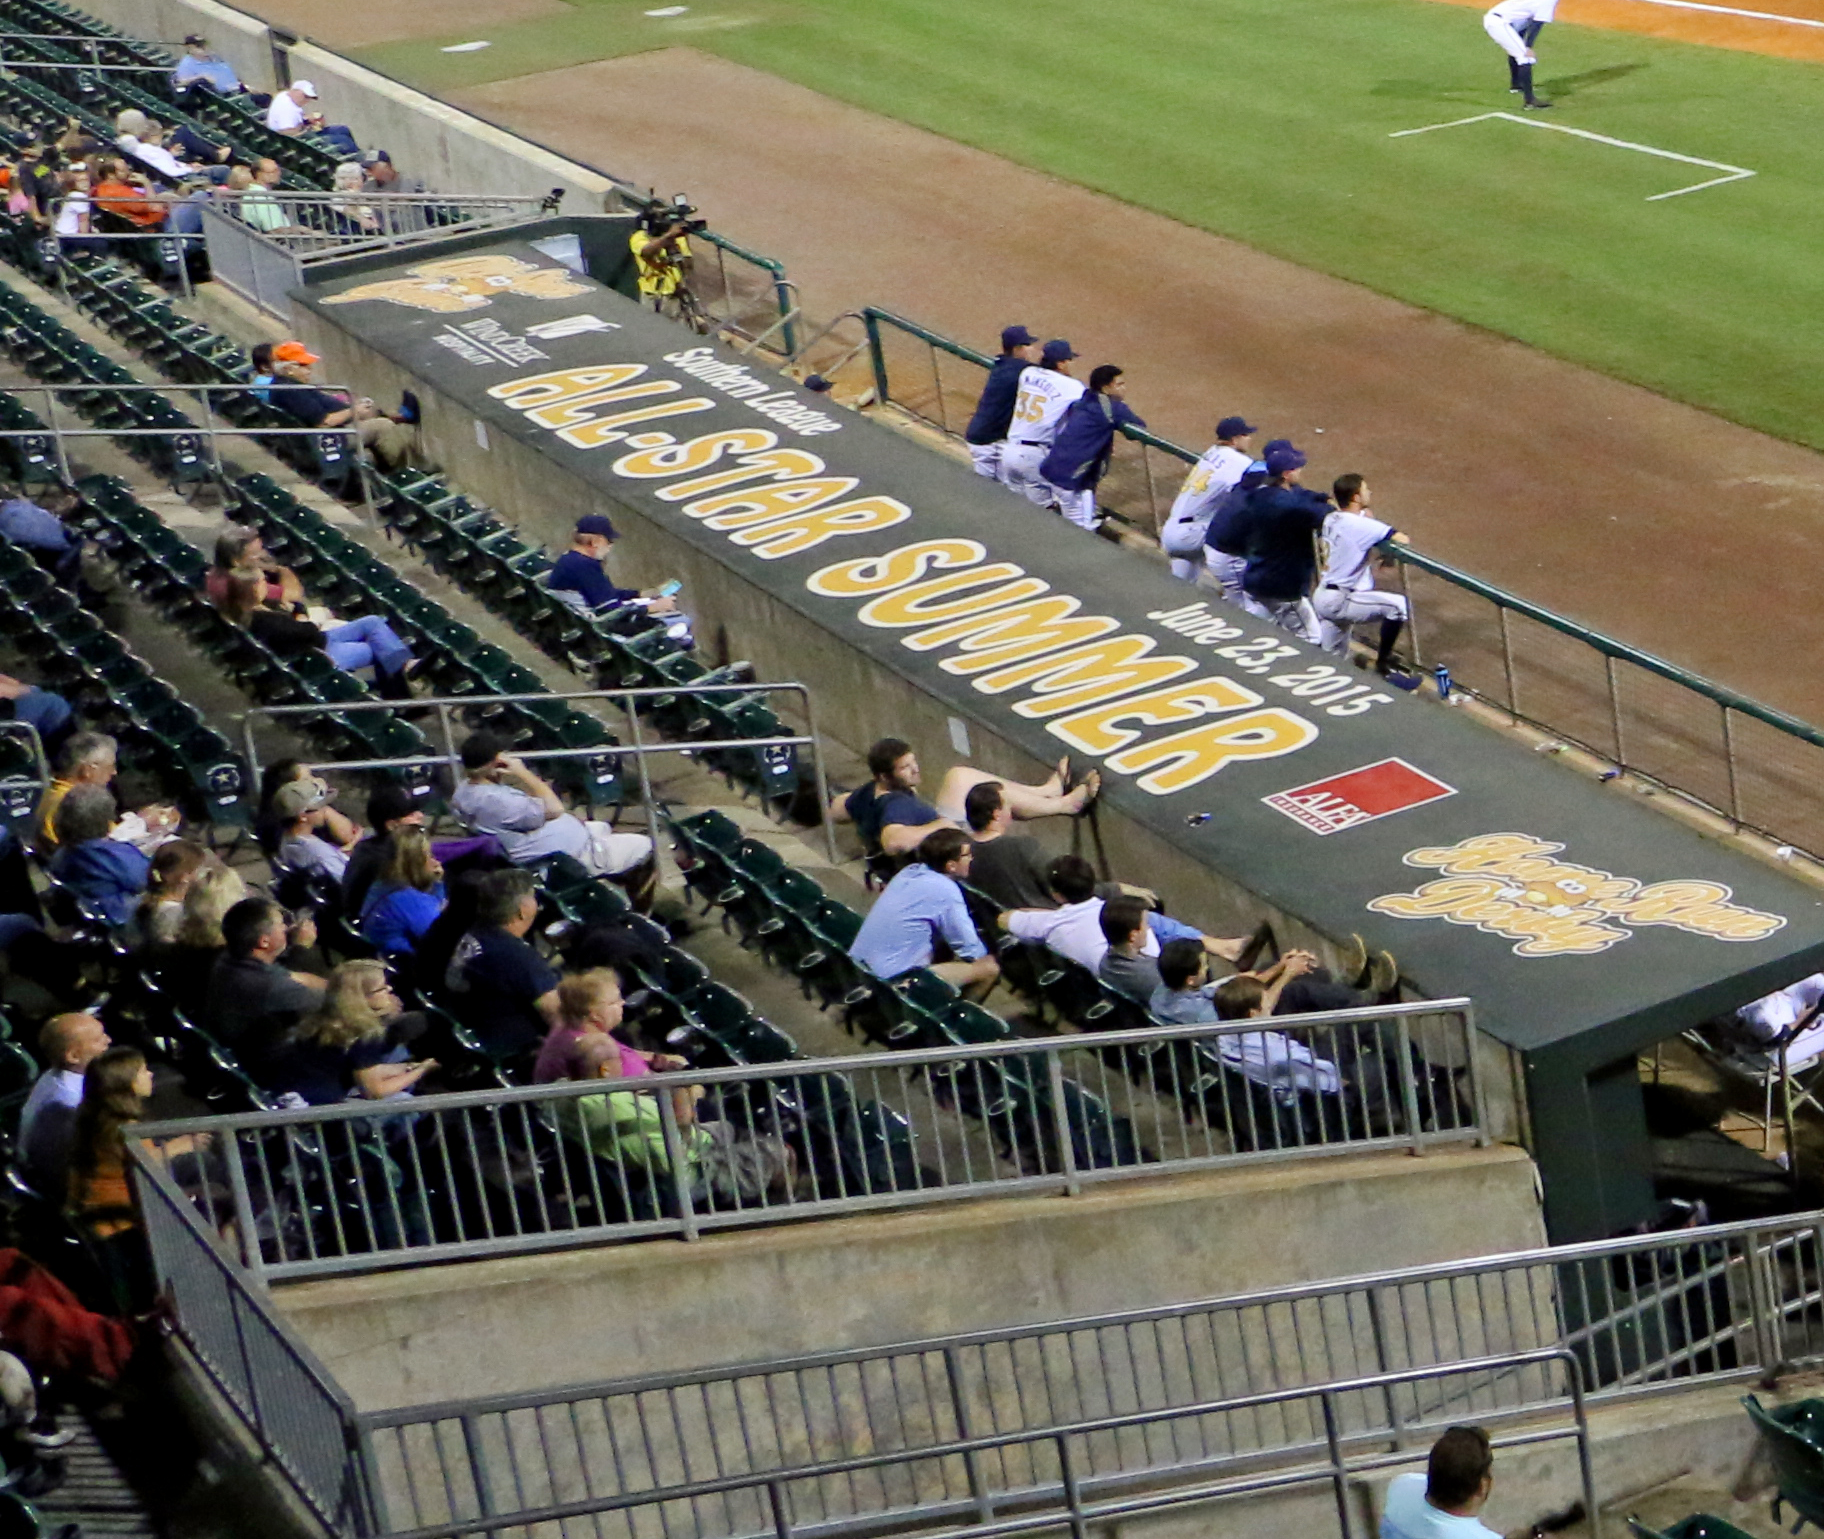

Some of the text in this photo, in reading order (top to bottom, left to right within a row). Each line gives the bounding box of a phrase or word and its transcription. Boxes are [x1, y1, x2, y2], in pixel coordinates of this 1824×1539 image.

[663, 347, 843, 436] Southern League
[487, 363, 1319, 796] ALL-STAR SUMMER
[1147, 602, 1395, 717] June 23, 2015
[1270, 795, 1336, 832] INSURANCE
[1293, 792, 1372, 827] ALFA
[1366, 875, 1634, 958] Derby
[1402, 832, 1789, 942] Home Run
